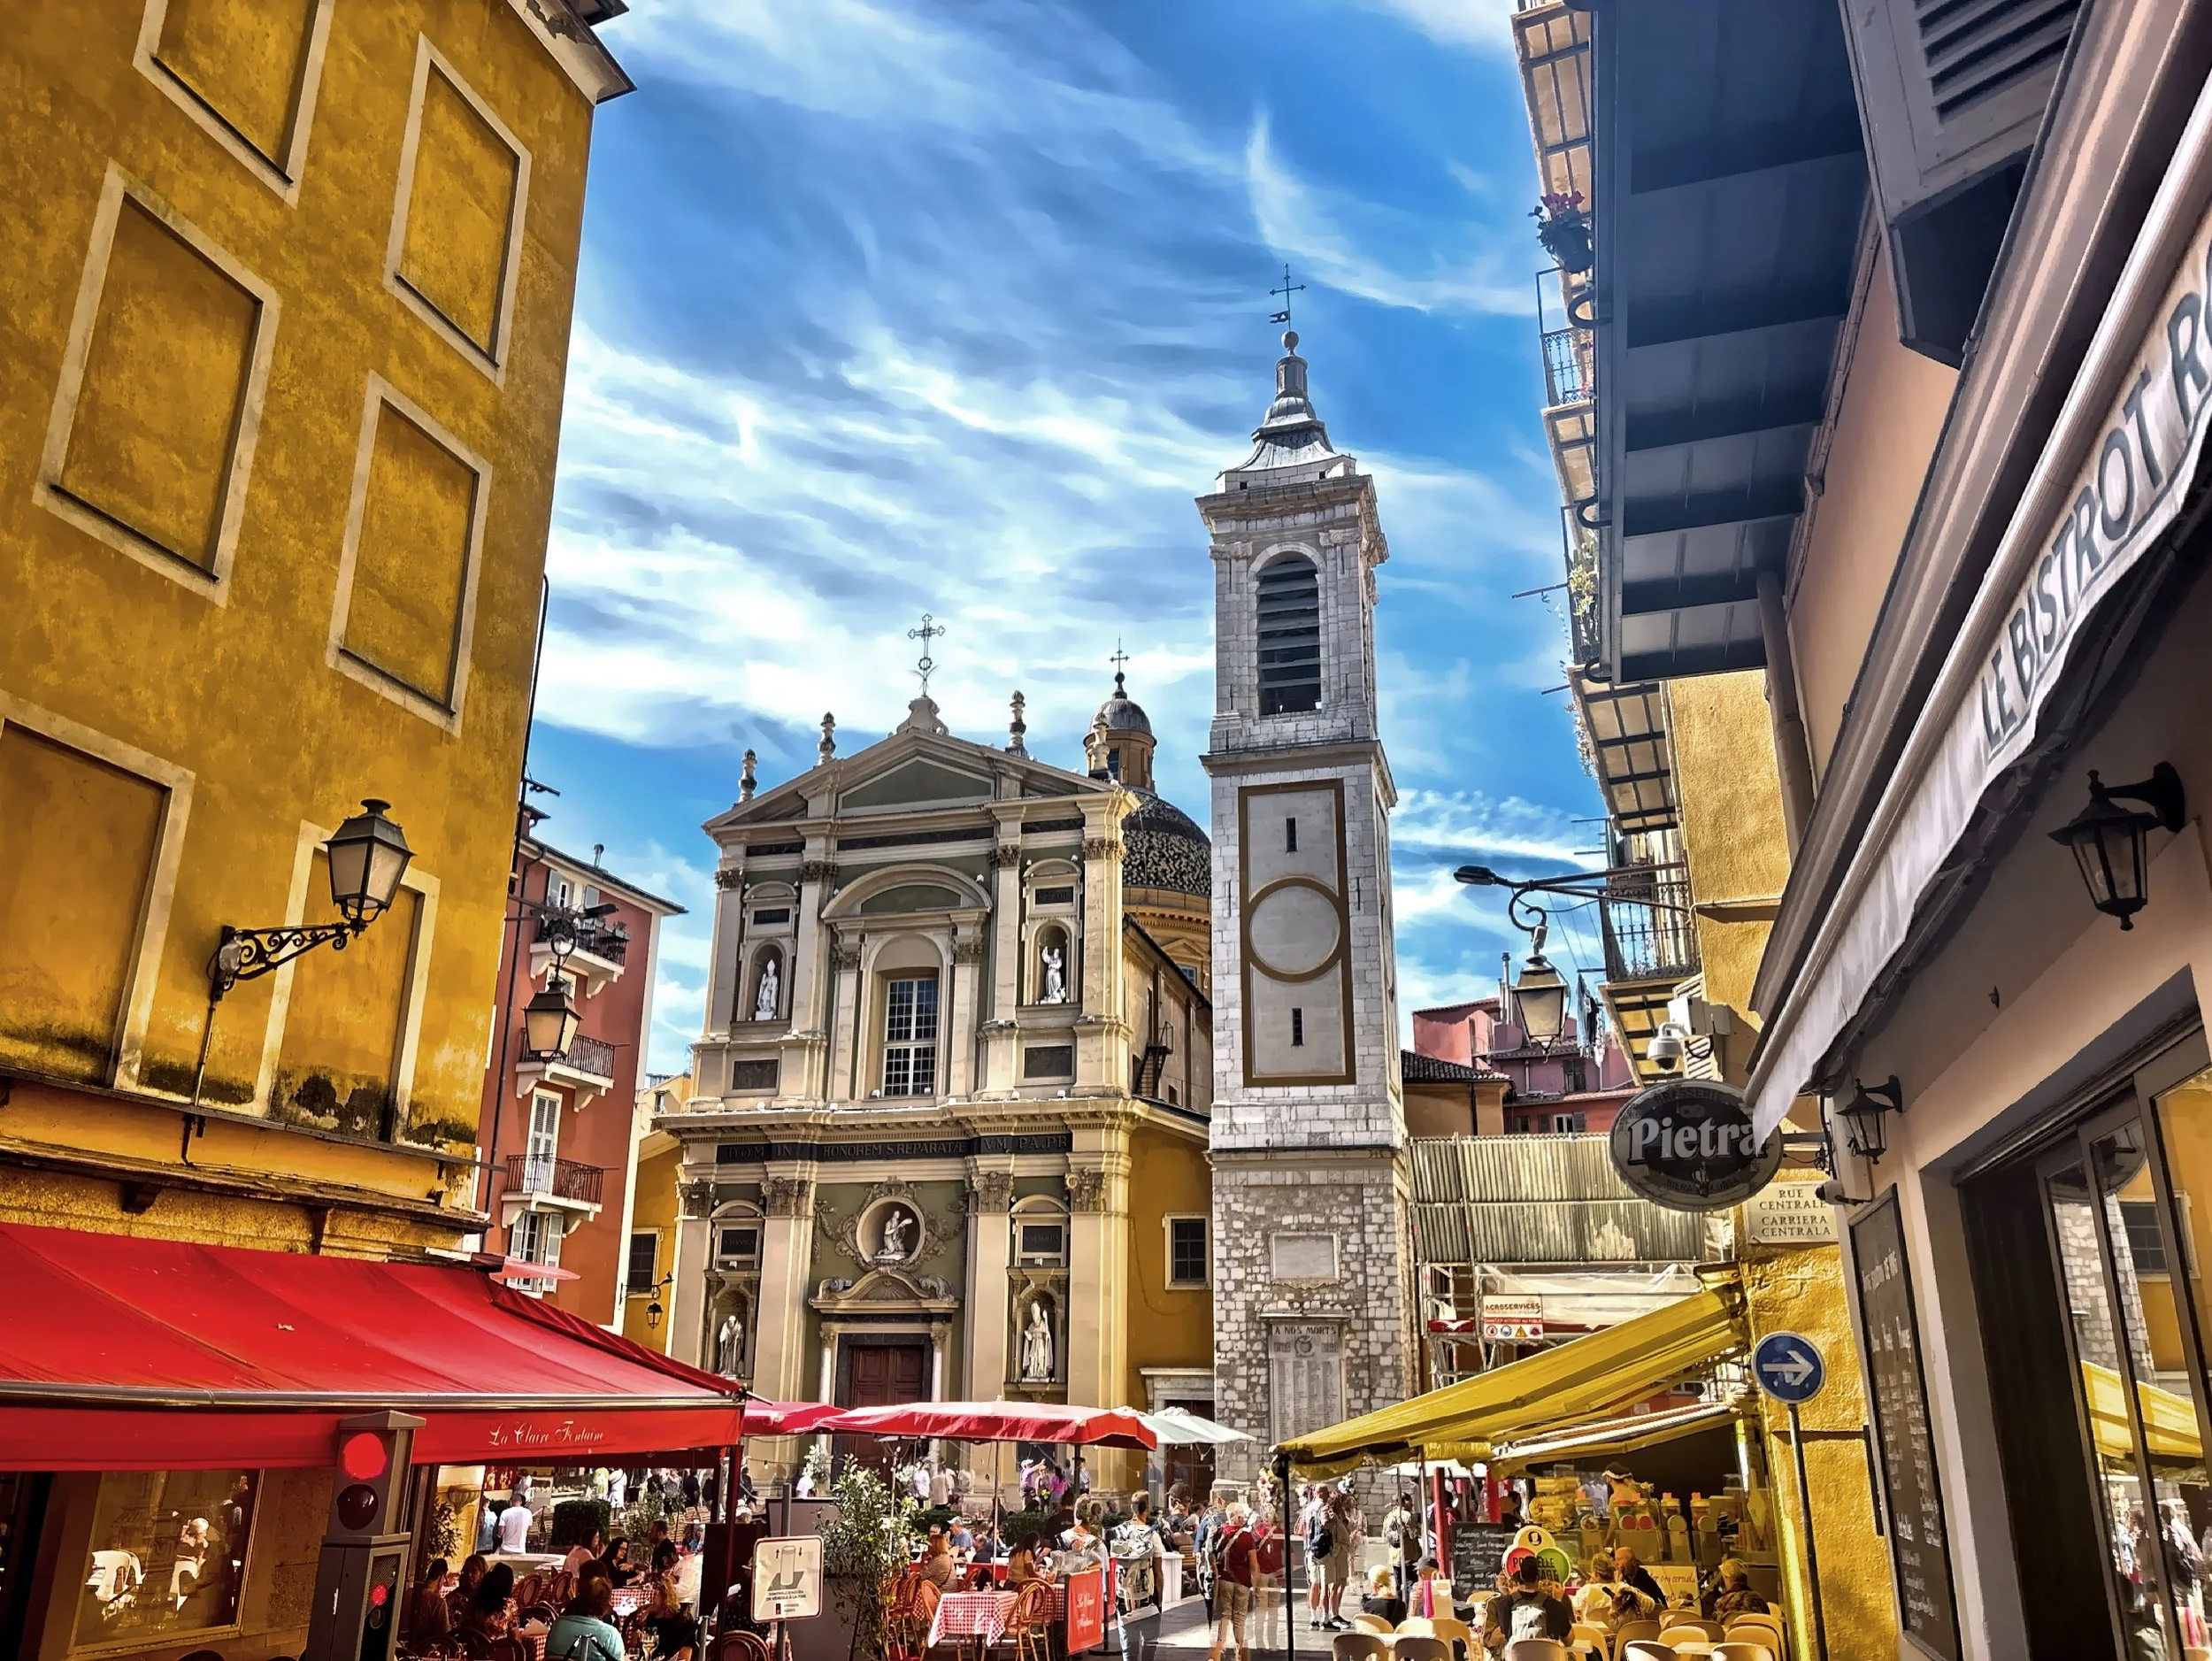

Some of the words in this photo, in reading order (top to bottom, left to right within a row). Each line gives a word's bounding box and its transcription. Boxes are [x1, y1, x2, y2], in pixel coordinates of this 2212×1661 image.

[1980, 643, 2018, 750] LE
[2008, 362, 2164, 704] BISTROT
[1628, 1116, 1766, 1165] Pietra
[777, 1144, 792, 1157] IN
[823, 1143, 881, 1157] HONOREM
[1778, 1189, 1804, 1198] RUE
[1759, 1200, 1826, 1211] CENTRALE
[1761, 1216, 1827, 1227] CARRIERA
[1761, 1227, 1831, 1237] CENTRALA
[488, 1422, 509, 1446] La
[513, 1422, 550, 1444] Claire
